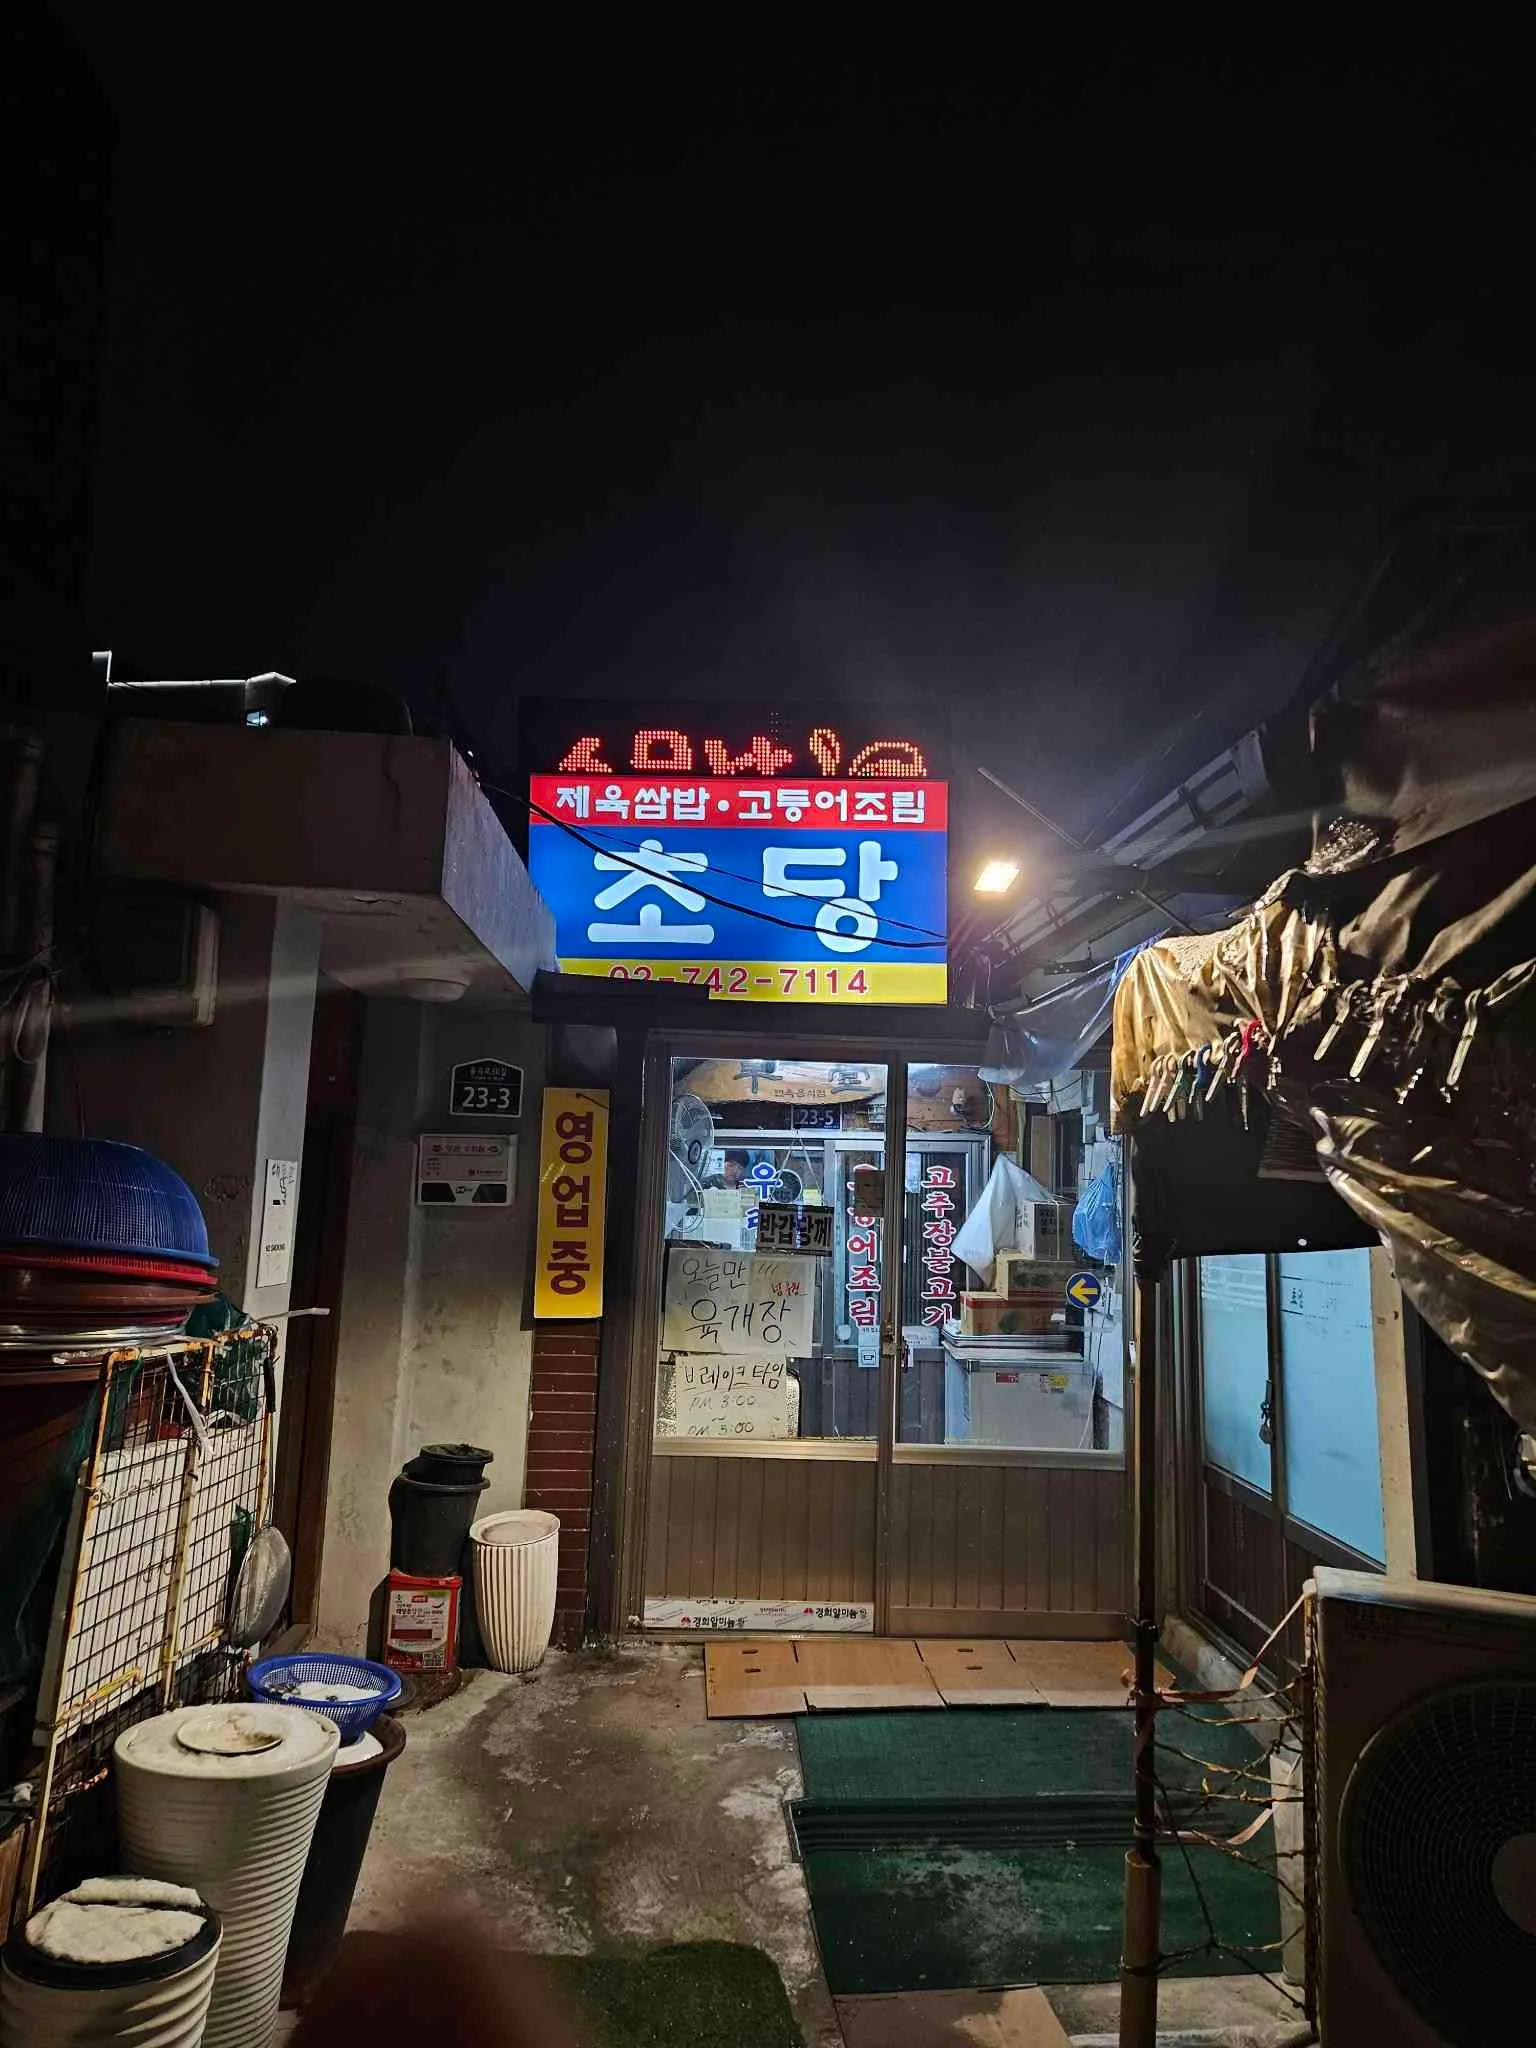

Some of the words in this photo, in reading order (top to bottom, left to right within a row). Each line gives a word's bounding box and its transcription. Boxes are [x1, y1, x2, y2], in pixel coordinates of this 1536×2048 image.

[462, 1086, 510, 1109] 23-3
[799, 1109, 834, 1126] 23-5
[920, 1165, 957, 1327] 고추장불고기
[682, 1256, 747, 1291] 오늘만
[685, 1298, 792, 1344] 육개장
[682, 1363, 751, 1392] 브레이크
[752, 1361, 785, 1390] 타임
